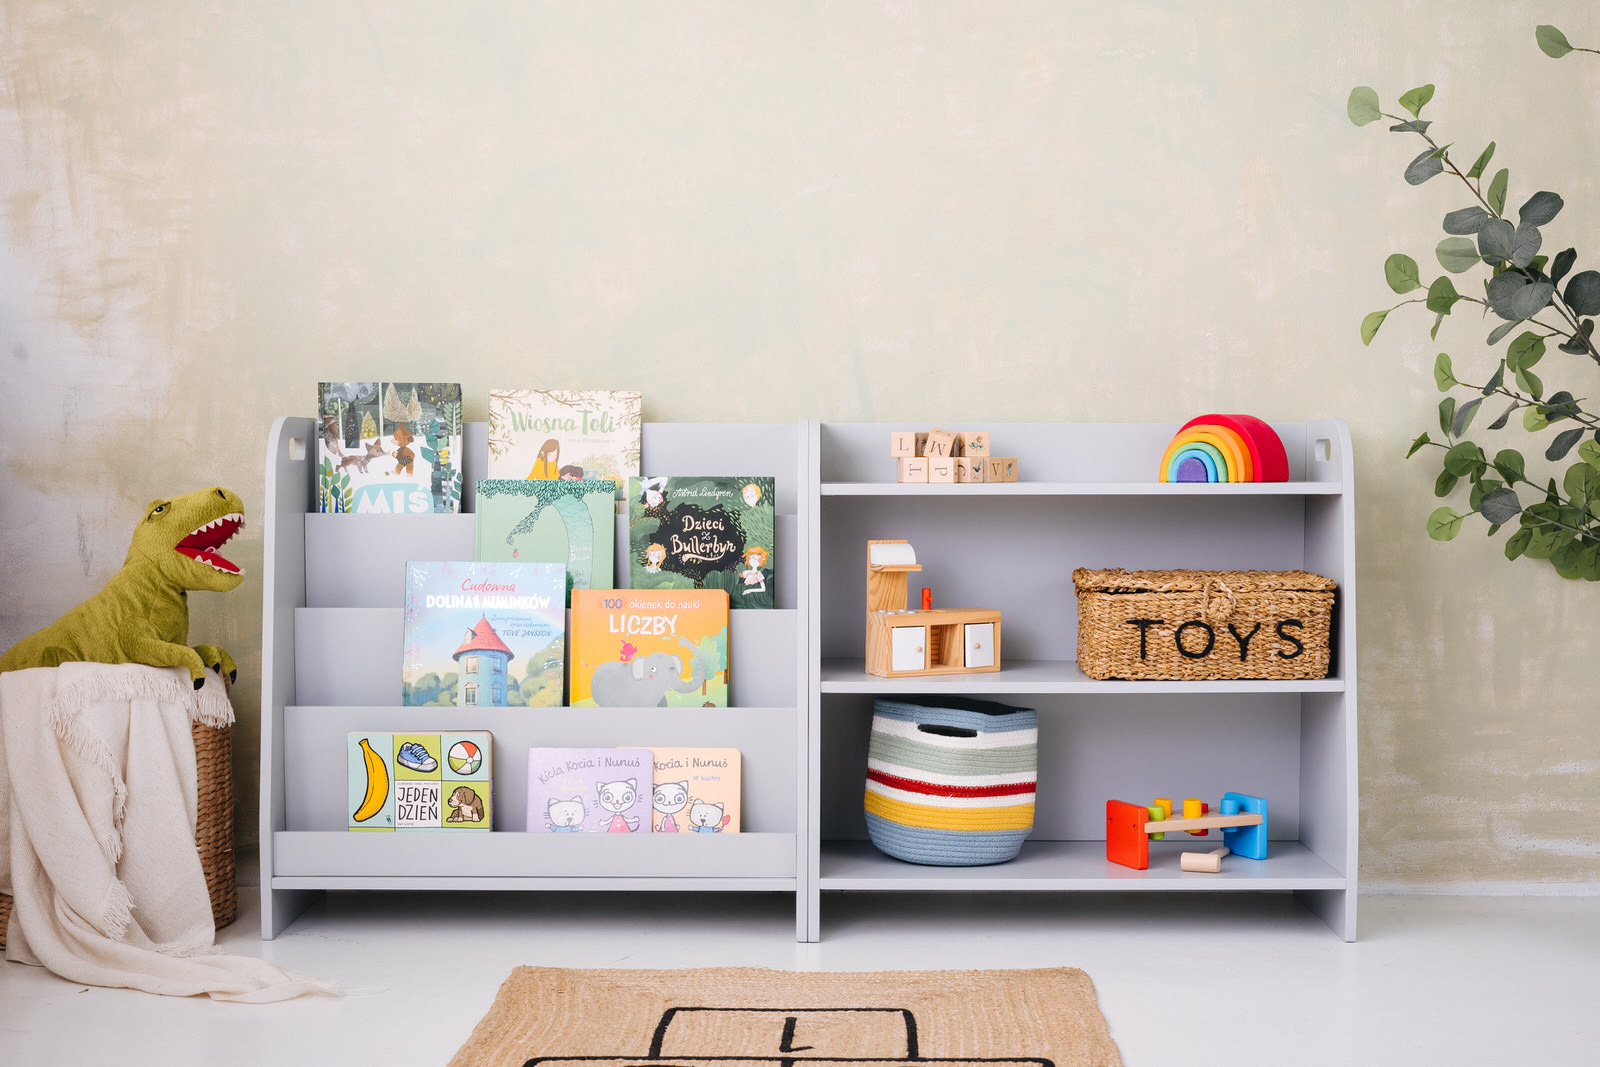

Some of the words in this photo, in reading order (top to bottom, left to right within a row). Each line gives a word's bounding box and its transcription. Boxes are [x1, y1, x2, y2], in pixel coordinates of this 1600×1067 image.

[510, 411, 577, 434] Wiosna
[576, 409, 616, 435] Toli
[899, 438, 909, 451] L
[991, 462, 1001, 476] V
[357, 486, 430, 513] MIŚ
[672, 487, 699, 499] Astrid
[699, 486, 734, 500] Lindgren
[681, 515, 725, 533] Dzieci
[670, 534, 736, 561] Bullerbyn
[461, 578, 516, 593] Cudowna
[604, 598, 623, 609] 100
[629, 599, 662, 609] okienek
[664, 599, 676, 609] do
[678, 599, 700, 609] nauki
[609, 614, 679, 635] LICZBY
[1126, 618, 1304, 662] TOYS
[538, 765, 564, 785] Kicia
[565, 758, 596, 771] Kocia
[597, 757, 601, 768] i
[604, 757, 641, 768] Nunuś
[653, 758, 683, 772] Kocia
[685, 757, 689, 768] i
[692, 757, 728, 769] Nunuś
[397, 786, 438, 803] JEDEN
[398, 803, 438, 821] DZIEŃ
